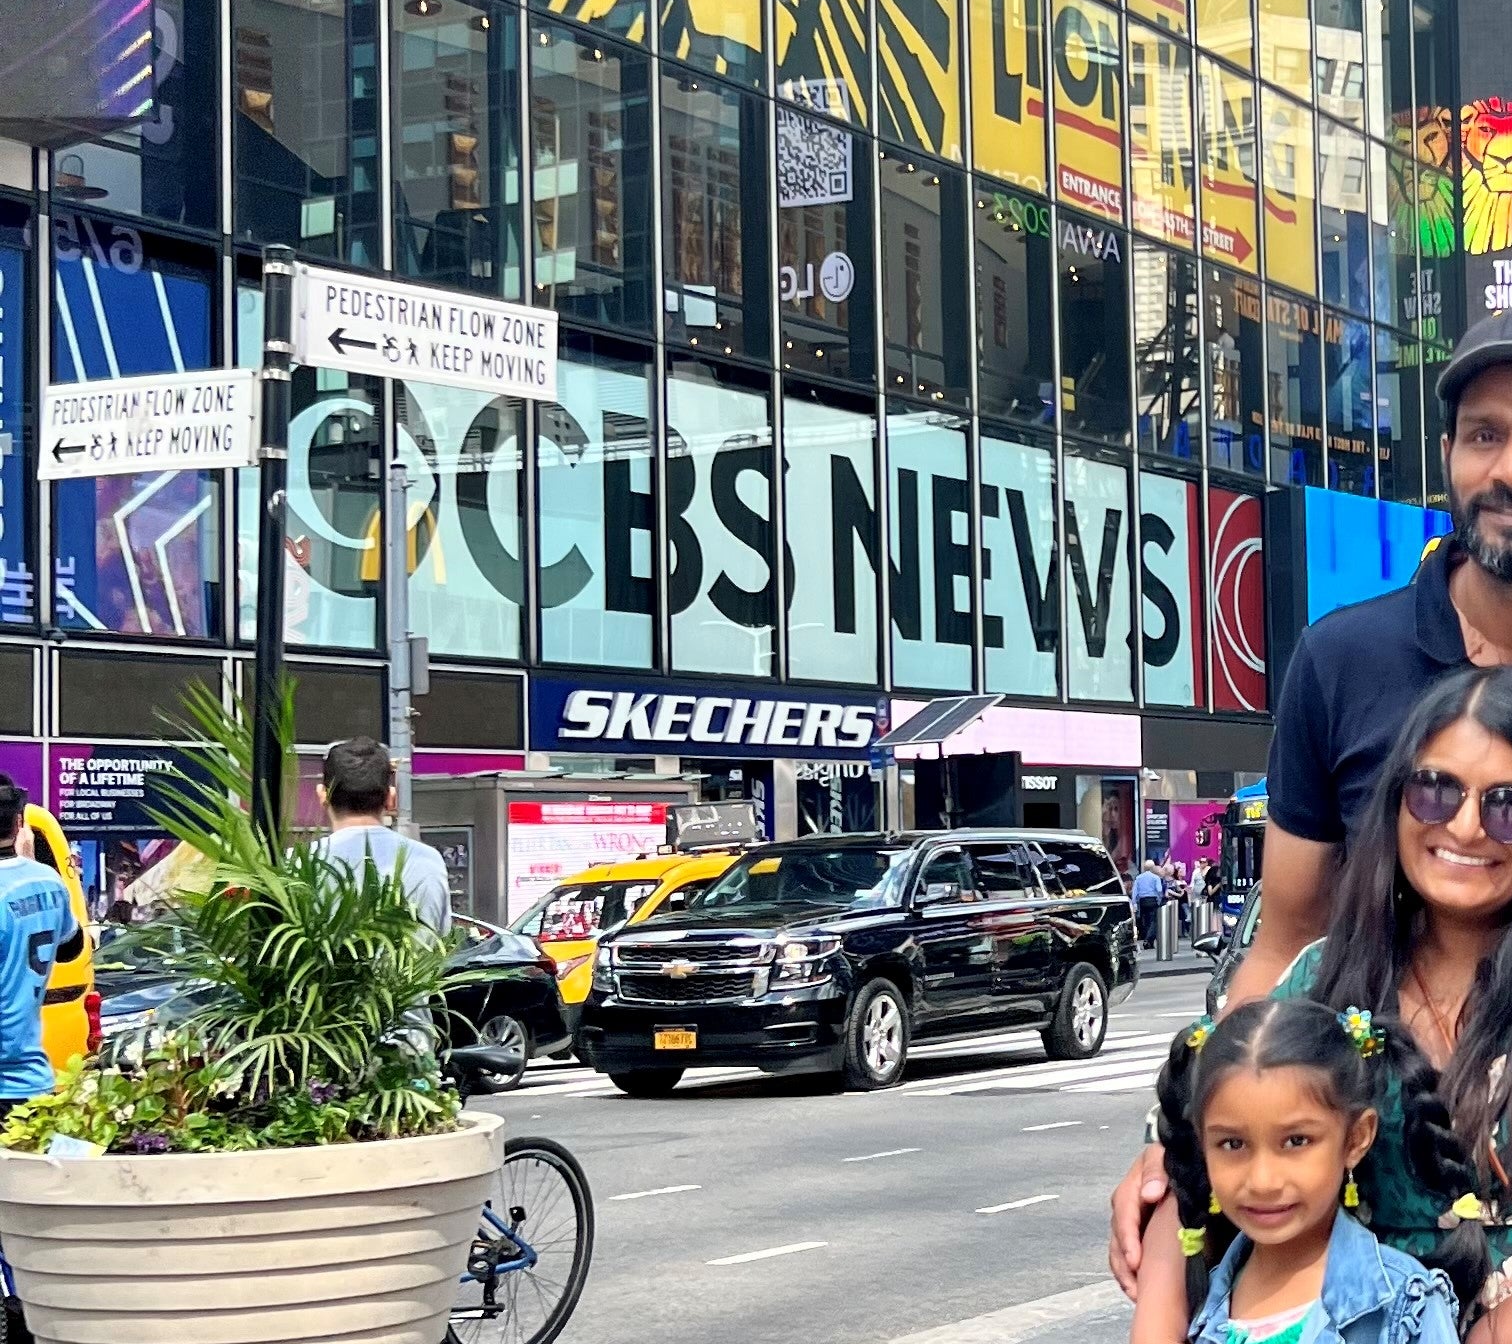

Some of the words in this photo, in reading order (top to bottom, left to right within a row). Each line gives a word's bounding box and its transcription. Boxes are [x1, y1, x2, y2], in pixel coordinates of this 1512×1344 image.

[1062, 171, 1121, 206] ENTRANCE
[1202, 223, 1235, 253] STREET
[326, 285, 443, 332] PEDESTRIAN
[449, 307, 496, 338] FLOW
[502, 316, 547, 349] ZONE
[430, 342, 474, 374] KEEP
[481, 350, 546, 386] MOVING
[52, 392, 141, 425] PEDESTRIAN
[146, 388, 187, 417] FLOW
[192, 384, 235, 414] ZONE
[126, 428, 164, 457] KEEP
[169, 424, 234, 455] MOVING
[456, 394, 796, 629] CBS
[830, 453, 1181, 668] NEWS
[557, 689, 876, 748] SKECHERS
[59, 757, 85, 771] THE
[86, 758, 173, 772] OPPORTUNITY
[59, 772, 77, 785] OF
[79, 773, 89, 785] A
[90, 773, 145, 786] LIFETIME
[76, 812, 90, 821] ALL
